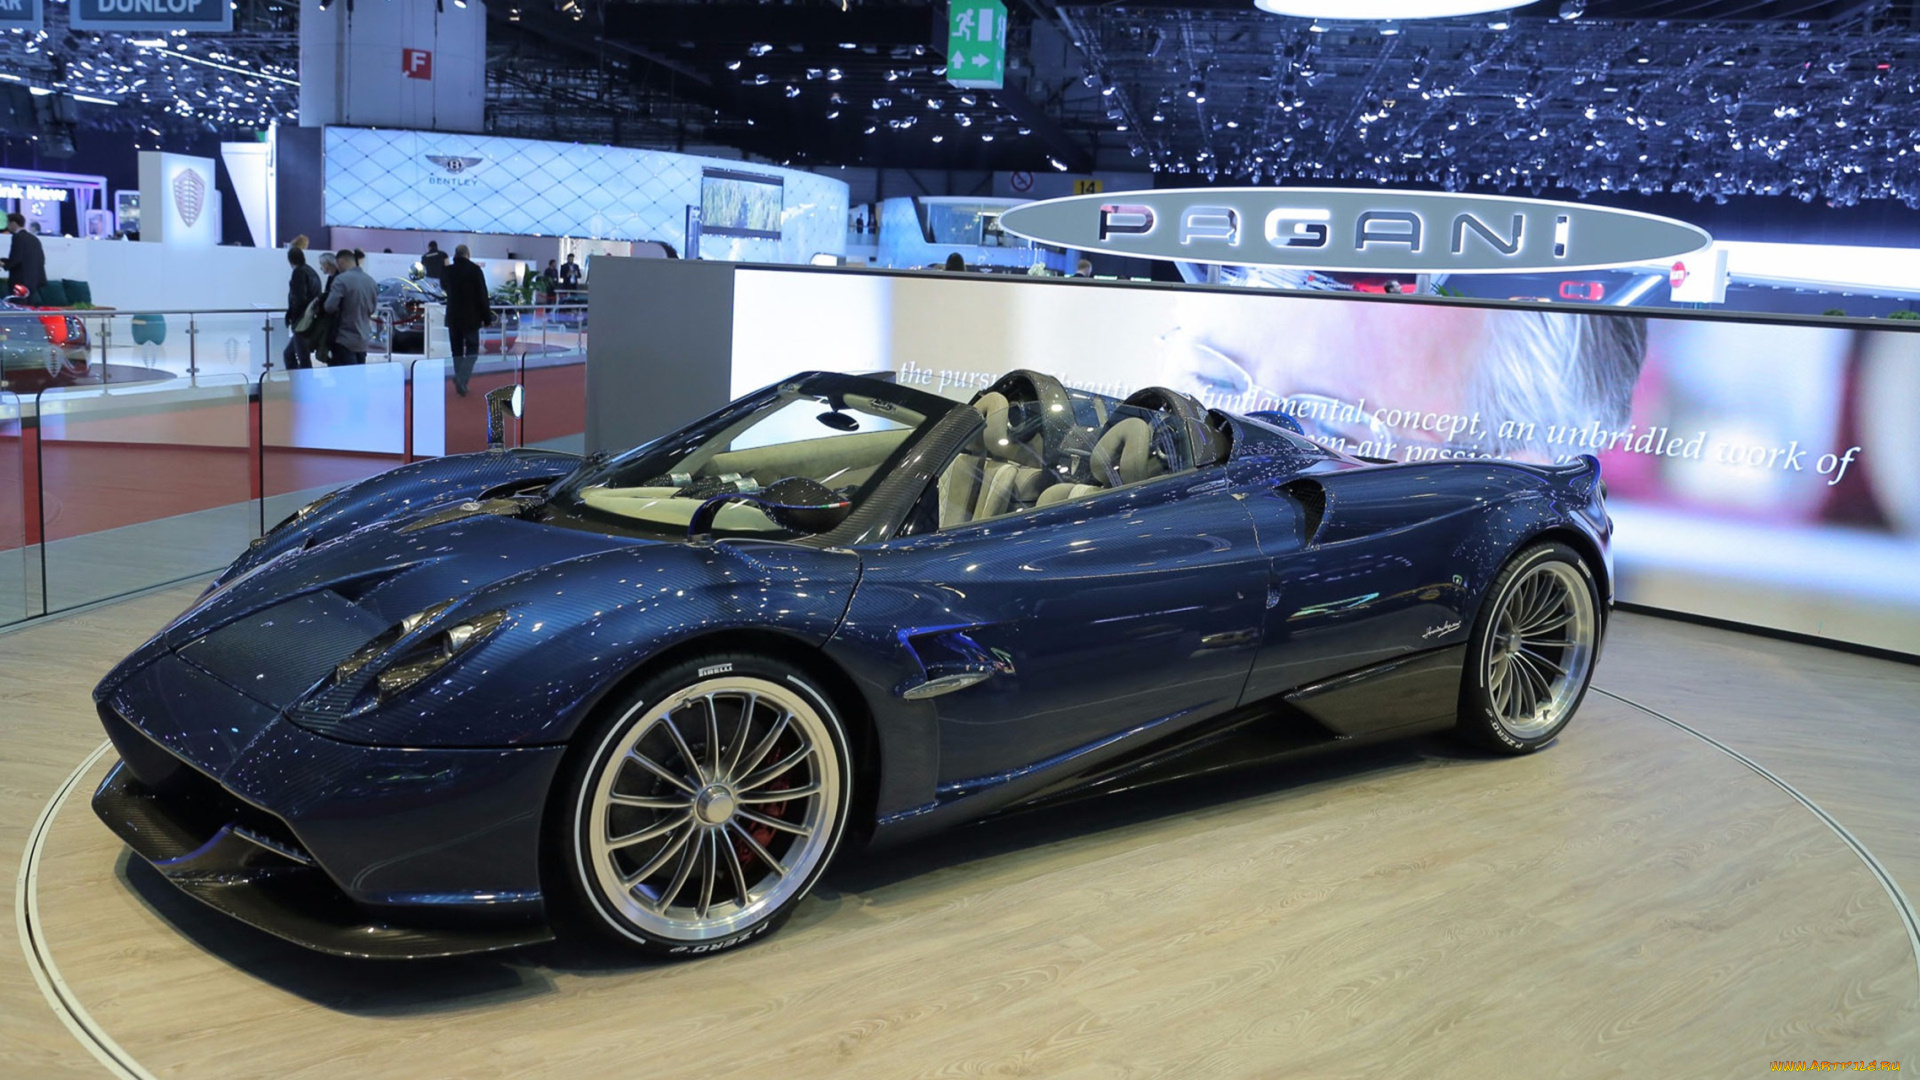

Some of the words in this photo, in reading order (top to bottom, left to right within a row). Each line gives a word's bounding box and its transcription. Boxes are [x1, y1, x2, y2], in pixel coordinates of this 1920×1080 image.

[98, 0, 201, 13] DUNLOP
[410, 51, 427, 72] F
[429, 177, 478, 186] BENTLEY
[1081, 181, 1096, 194] 14
[1099, 204, 1569, 258] PAGANI
[900, 361, 931, 385] the
[938, 367, 998, 393] purs
[1201, 385, 1366, 424] fundamental
[1374, 409, 1488, 442] concept,
[1498, 419, 1534, 441] an
[1547, 420, 1706, 460] unbridled
[1715, 441, 1807, 472] work
[1816, 446, 1862, 486] of
